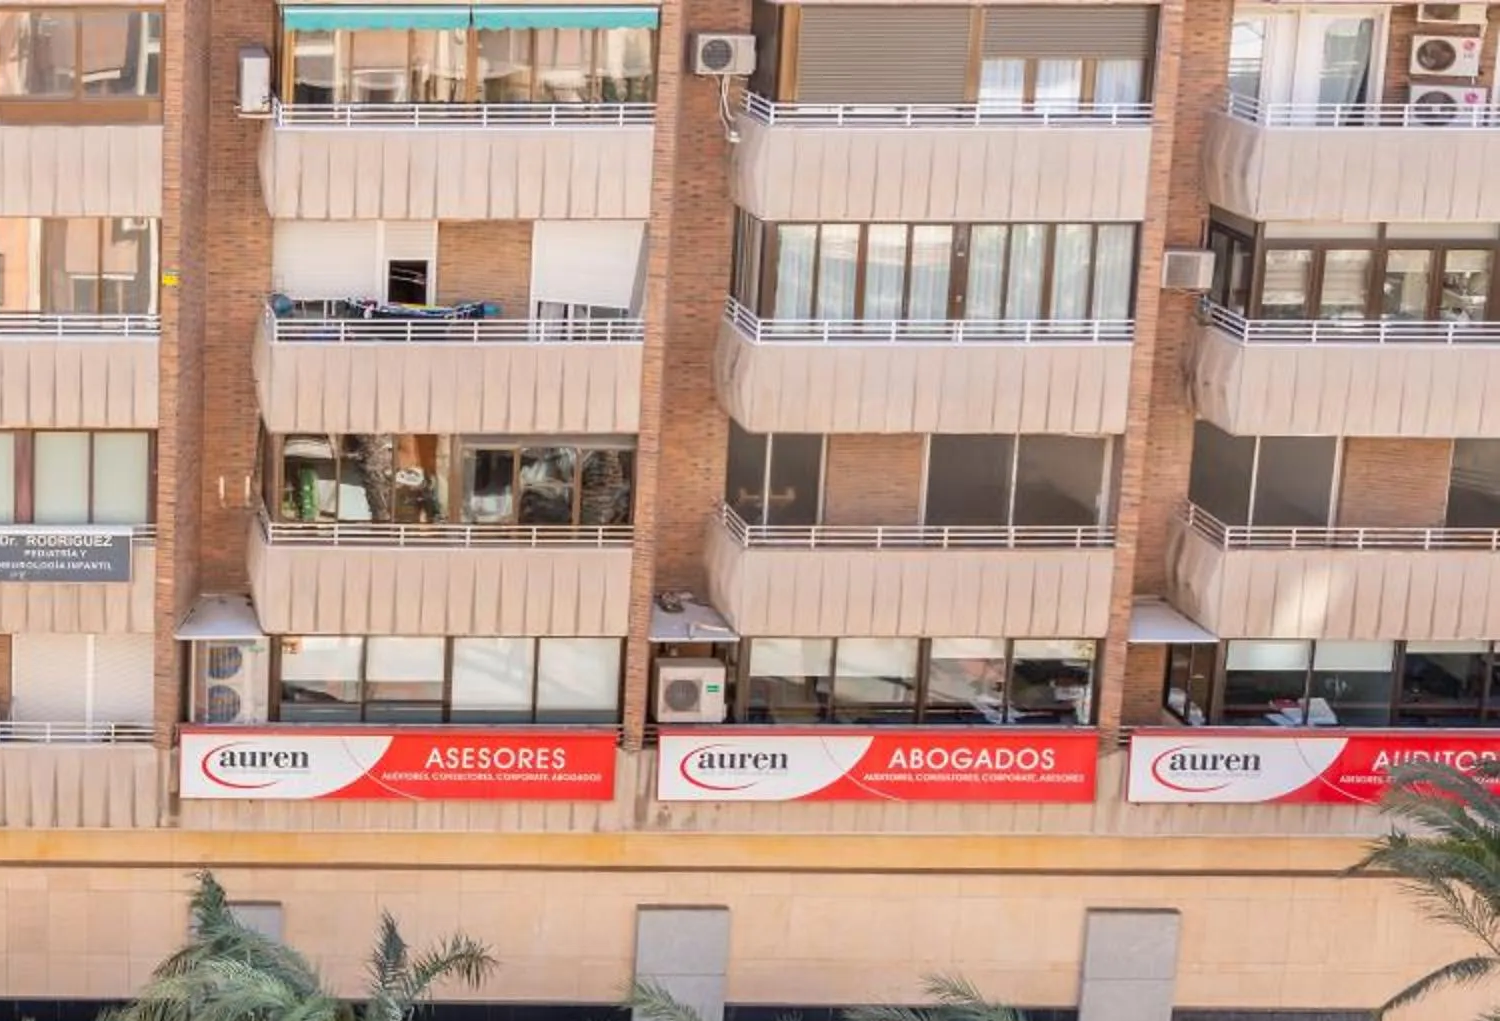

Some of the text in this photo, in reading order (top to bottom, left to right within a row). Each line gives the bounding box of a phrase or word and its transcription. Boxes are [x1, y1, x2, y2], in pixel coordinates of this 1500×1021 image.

[218, 747, 310, 768] auren
[425, 747, 566, 769] ASESORES
[697, 748, 788, 769] auren
[888, 747, 1055, 769] ABOGADOS
[1168, 752, 1261, 771] auren
